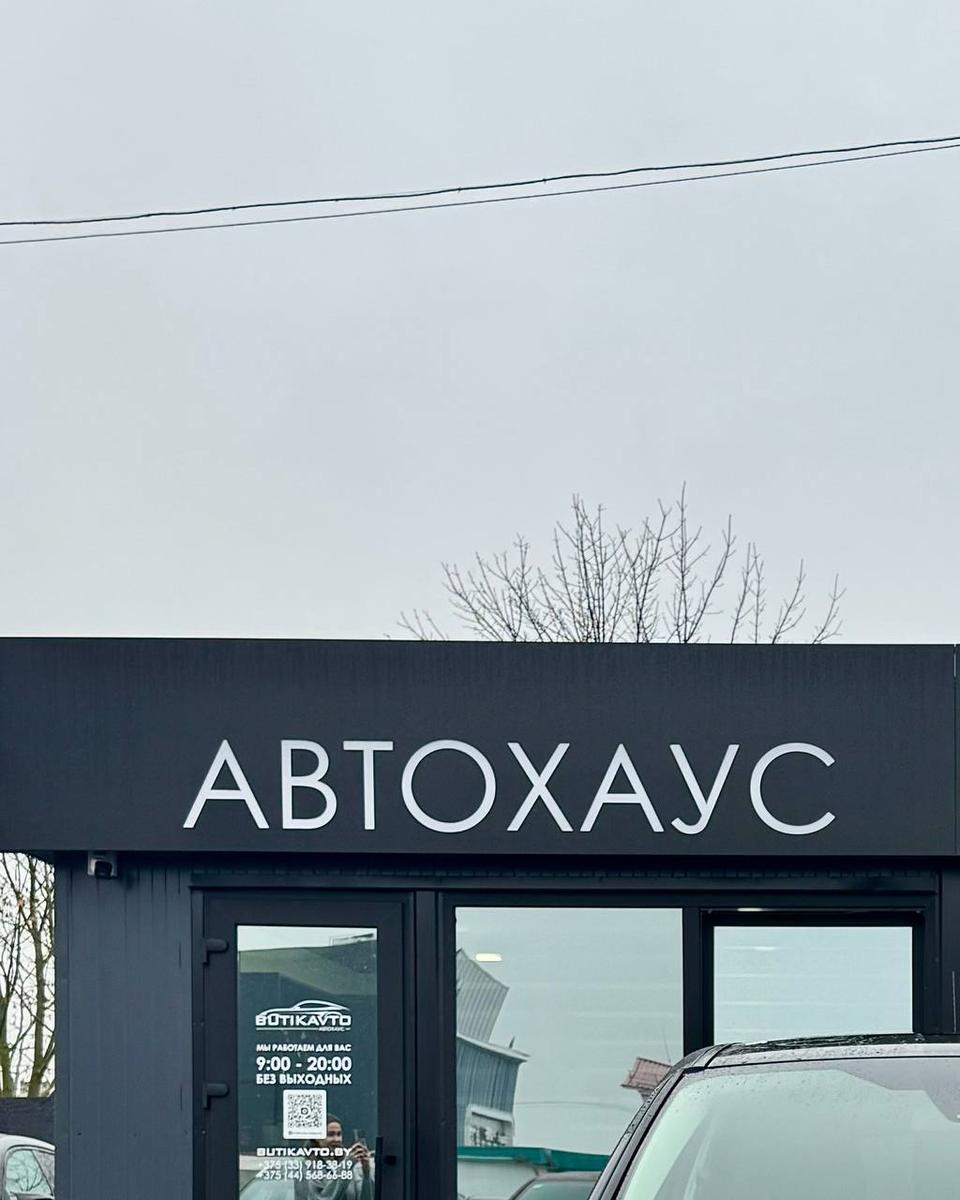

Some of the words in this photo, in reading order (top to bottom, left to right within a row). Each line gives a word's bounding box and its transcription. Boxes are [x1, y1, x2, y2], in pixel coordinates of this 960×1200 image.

[183, 738, 837, 836] АВТОХАУС
[255, 1014, 352, 1026] BUTIKAVTO
[256, 1044, 271, 1052] МЫ
[272, 1044, 315, 1052] РАБОТАЕМ
[316, 1044, 332, 1052] ДЛЯ
[334, 1044, 352, 1052] ВАС
[256, 1056, 291, 1071] 9:00
[307, 1056, 352, 1071] 20:00
[256, 1074, 277, 1085] БЕЗ
[279, 1074, 352, 1086] ВЫХОДНЫХ
[256, 1148, 351, 1156] BUTIKAVTO.BY
[285, 1160, 303, 1171] (33)
[305, 1160, 353, 1170] 918-38-19
[285, 1170, 303, 1182] (44)
[305, 1170, 353, 1180] 568-66-88
